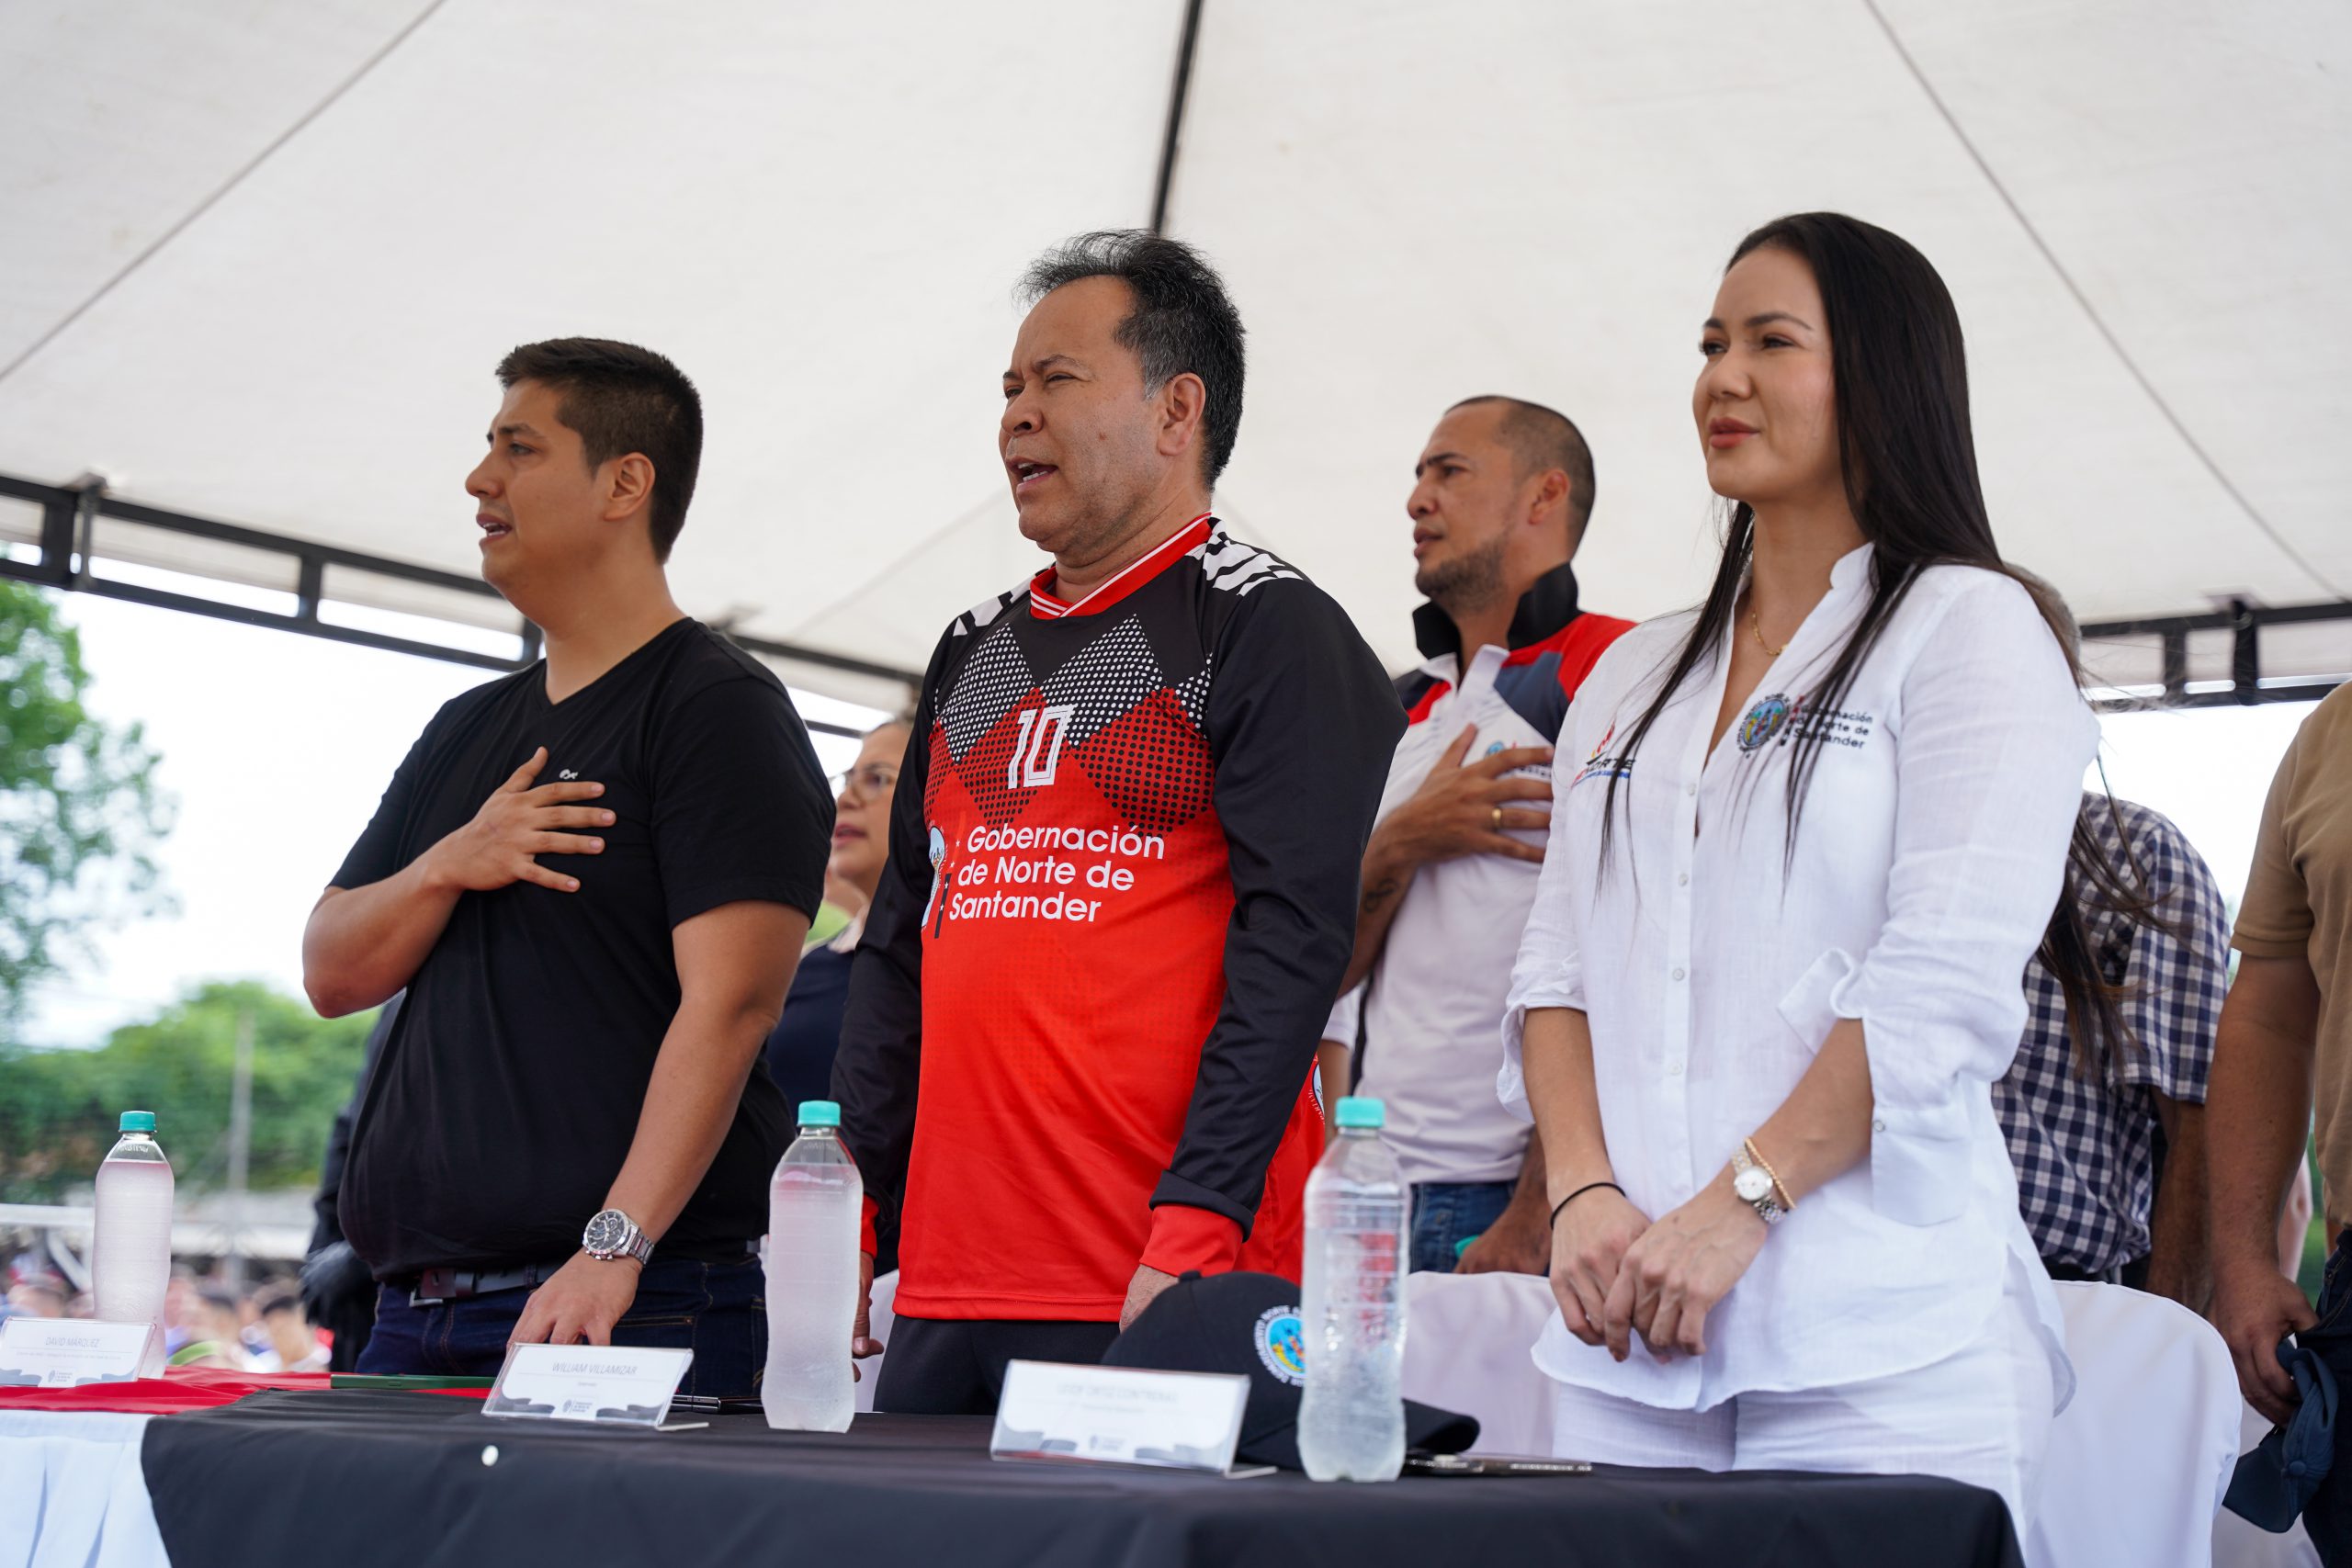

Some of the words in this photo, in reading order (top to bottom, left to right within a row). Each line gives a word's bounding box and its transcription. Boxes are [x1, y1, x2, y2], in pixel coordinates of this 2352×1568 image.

[1007, 705, 1076, 790] 10
[967, 823, 1166, 861] Gobernación
[957, 858, 988, 886] de
[994, 855, 1077, 885] Norte
[1086, 860, 1136, 892] de
[949, 892, 1102, 922] Santander
[552, 1362, 588, 1373] WILLIAM
[589, 1364, 639, 1376] VILLAMIZAR
